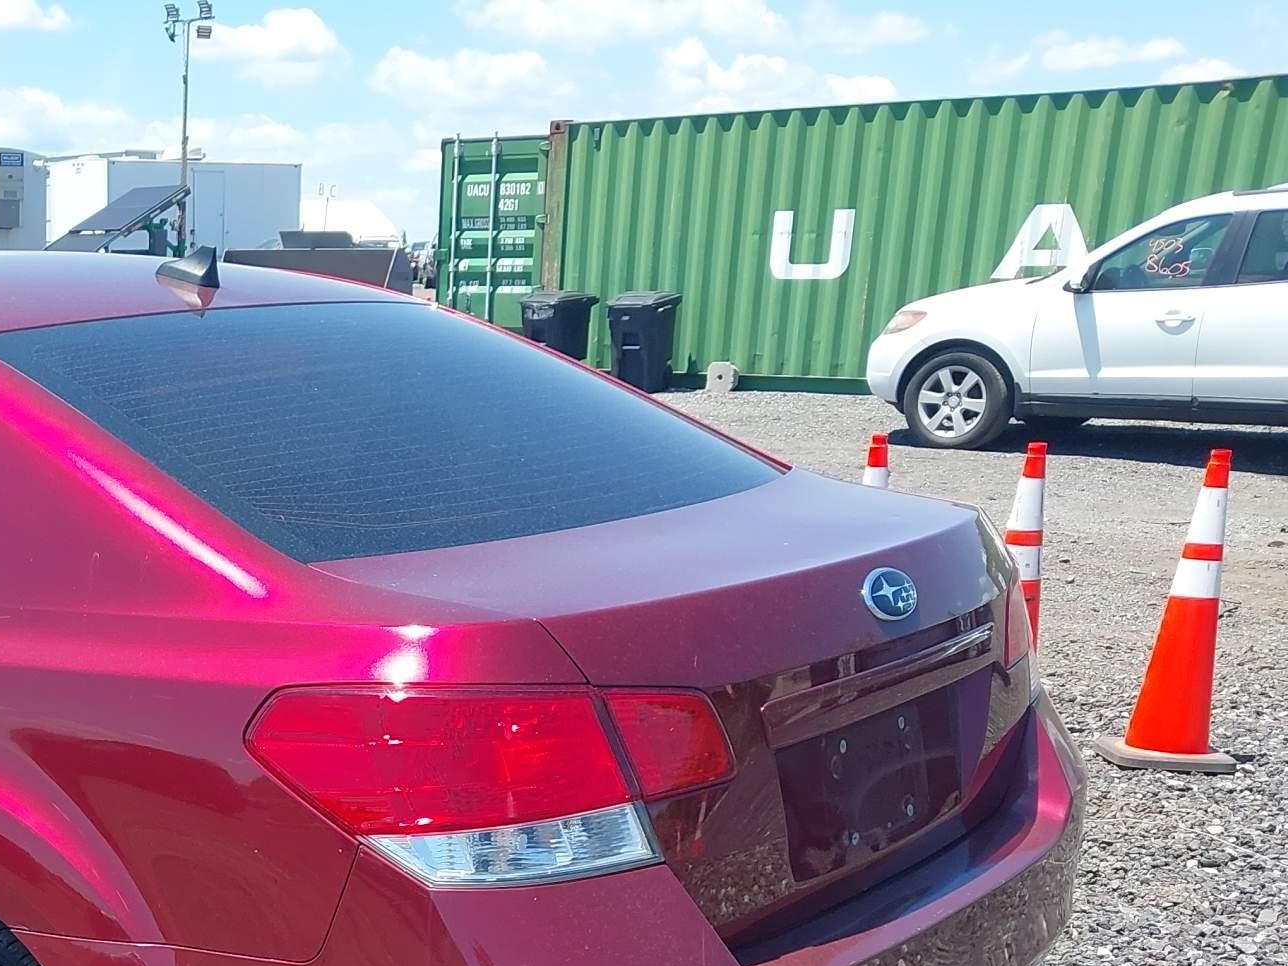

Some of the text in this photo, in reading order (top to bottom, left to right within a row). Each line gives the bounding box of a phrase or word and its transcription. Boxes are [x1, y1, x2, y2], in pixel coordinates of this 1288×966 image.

[467, 183, 489, 197] UACU
[499, 182, 531, 195] 830182
[498, 198, 519, 211] 42G1
[769, 203, 1089, 280] U A
[1145, 253, 1192, 277] 8605
